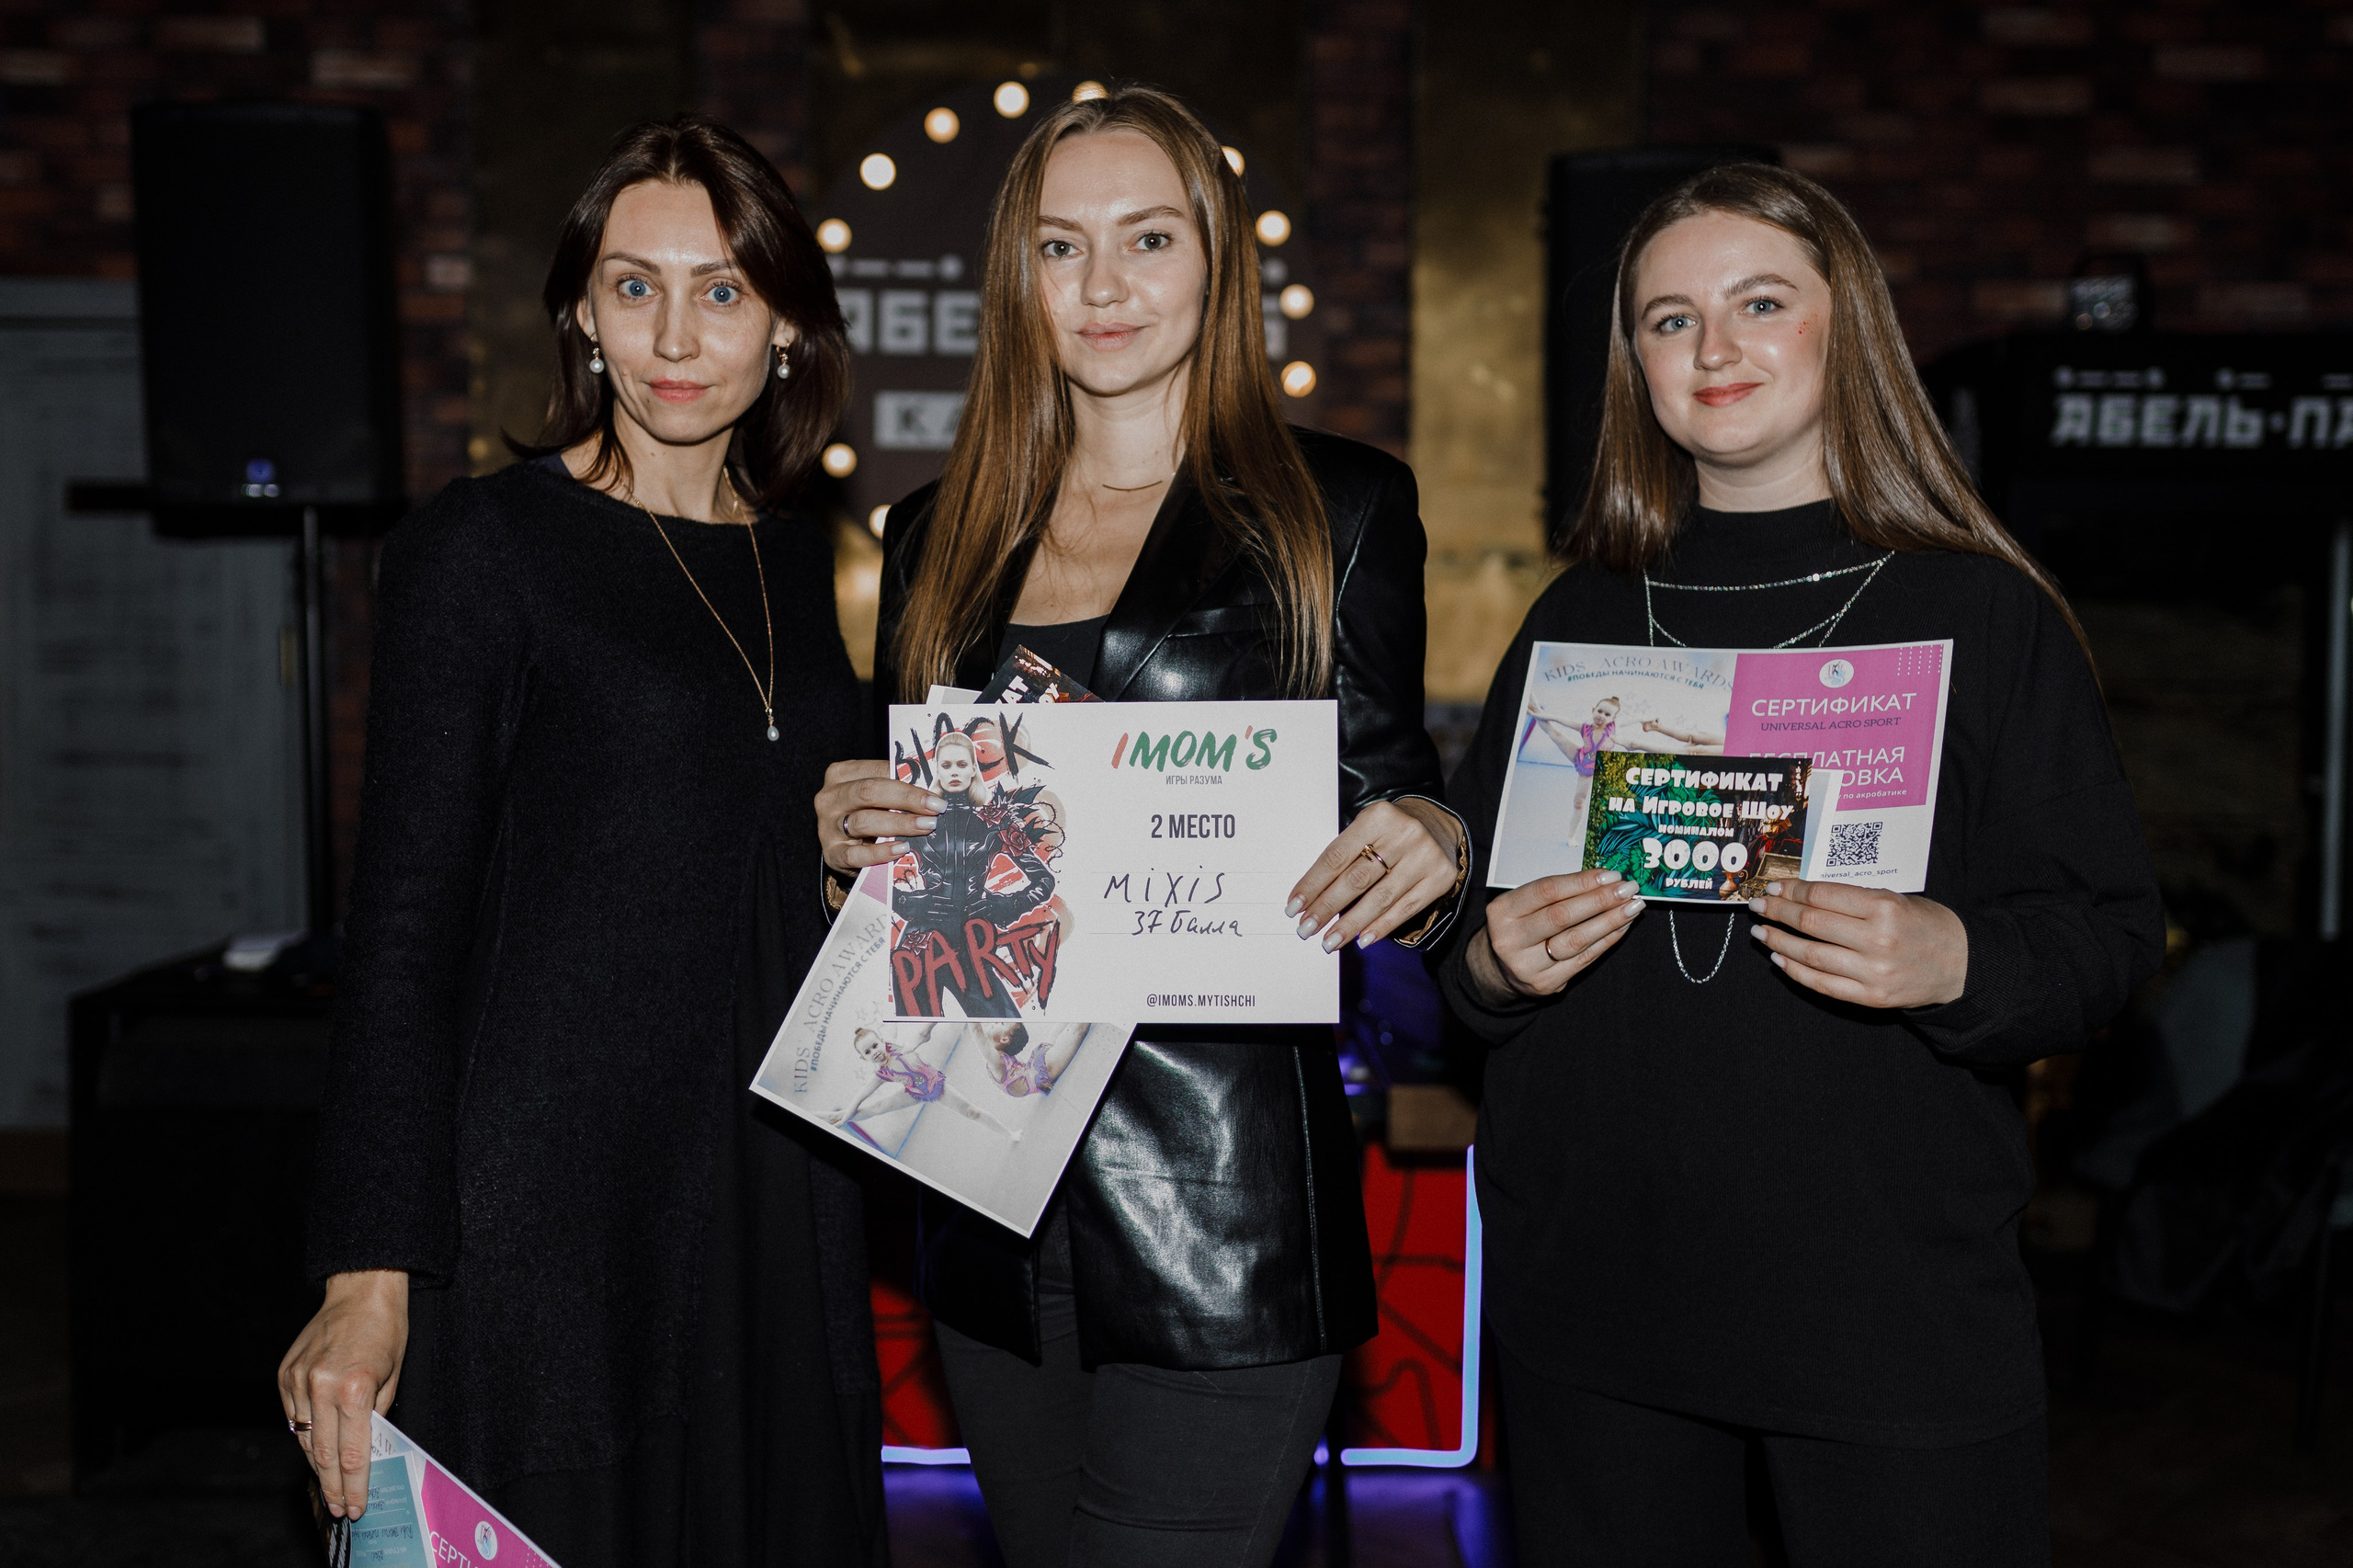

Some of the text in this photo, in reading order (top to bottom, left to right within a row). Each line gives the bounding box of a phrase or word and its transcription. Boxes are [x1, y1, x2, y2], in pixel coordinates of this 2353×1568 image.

[1611, 669, 1676, 681] НАЧИНАЮТСЯ
[1751, 692, 1917, 717] СЕРТИФИКАТ
[1761, 717, 1902, 732] UNIVERSAL ACRO SPORT
[1165, 775, 1222, 785] ИГРЫ РАЗУМА
[1625, 767, 1783, 792] СЕРТИФИКАТ
[1856, 790, 1908, 801] акробатике
[1643, 796, 1734, 818] ИГРОВОЕ
[1742, 801, 1795, 821] ШОУ
[1151, 814, 1235, 838] 2 МЕСТО
[1658, 824, 1735, 837] НОМИНАЛОМ
[1643, 837, 1748, 873] 3000
[1665, 877, 1714, 890] РУБЛЕЙ
[1820, 869, 1898, 880] niversal_acro_sport
[1131, 909, 1163, 936] 37
[891, 918, 1062, 1018] PARTY
[803, 978, 834, 1033] ACRO
[811, 1025, 827, 1072] #ПОБЕДЫ
[824, 961, 863, 1026] НАЧИНАЮТСЯ
[868, 937, 886, 957] ТЕБЯ
[1146, 994, 1256, 1007] @IMOMS.MYTISHCHI
